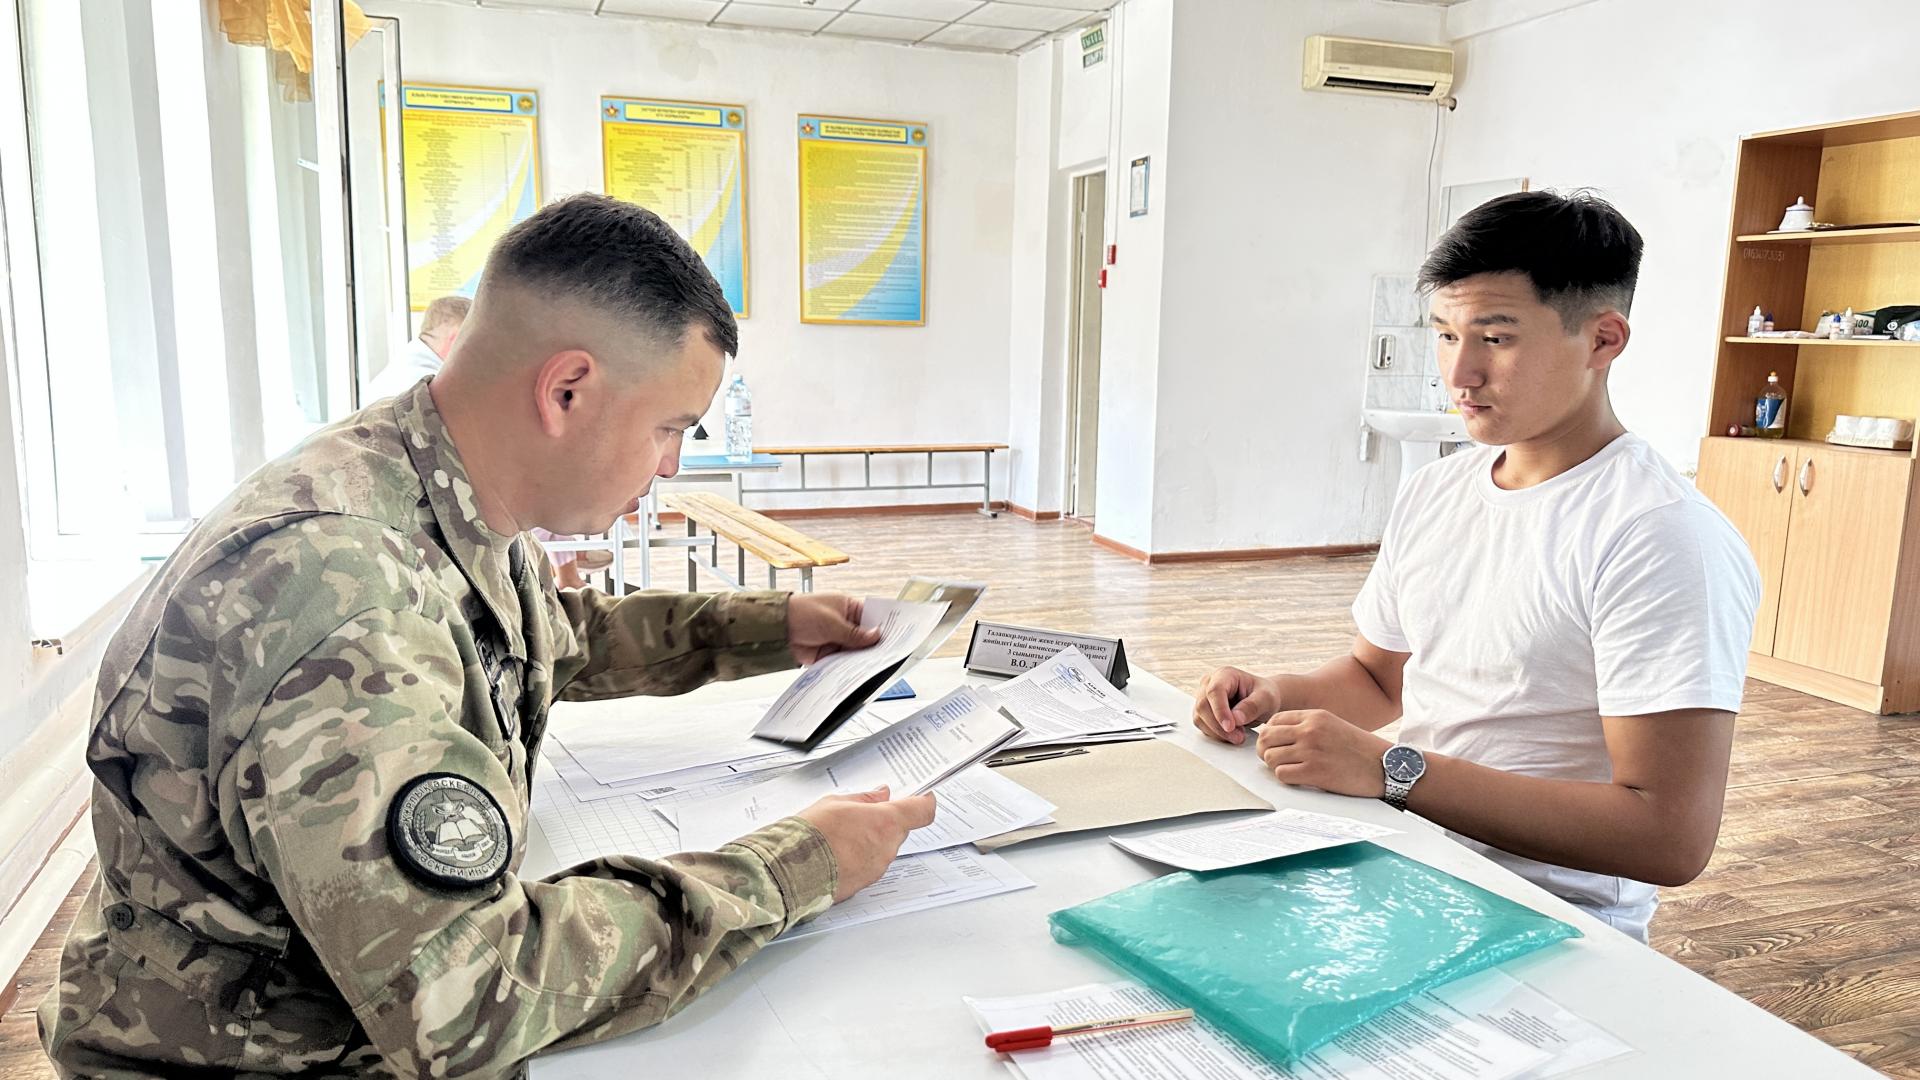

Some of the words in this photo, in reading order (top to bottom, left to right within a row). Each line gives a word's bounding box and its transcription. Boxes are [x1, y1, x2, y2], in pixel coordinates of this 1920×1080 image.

[983, 638, 1012, 647] жөніндегі
[1013, 641, 1027, 649] кіші
[1012, 650, 1044, 660] сыныпты
[420, 854, 465, 876] ӘСКЕРИ
